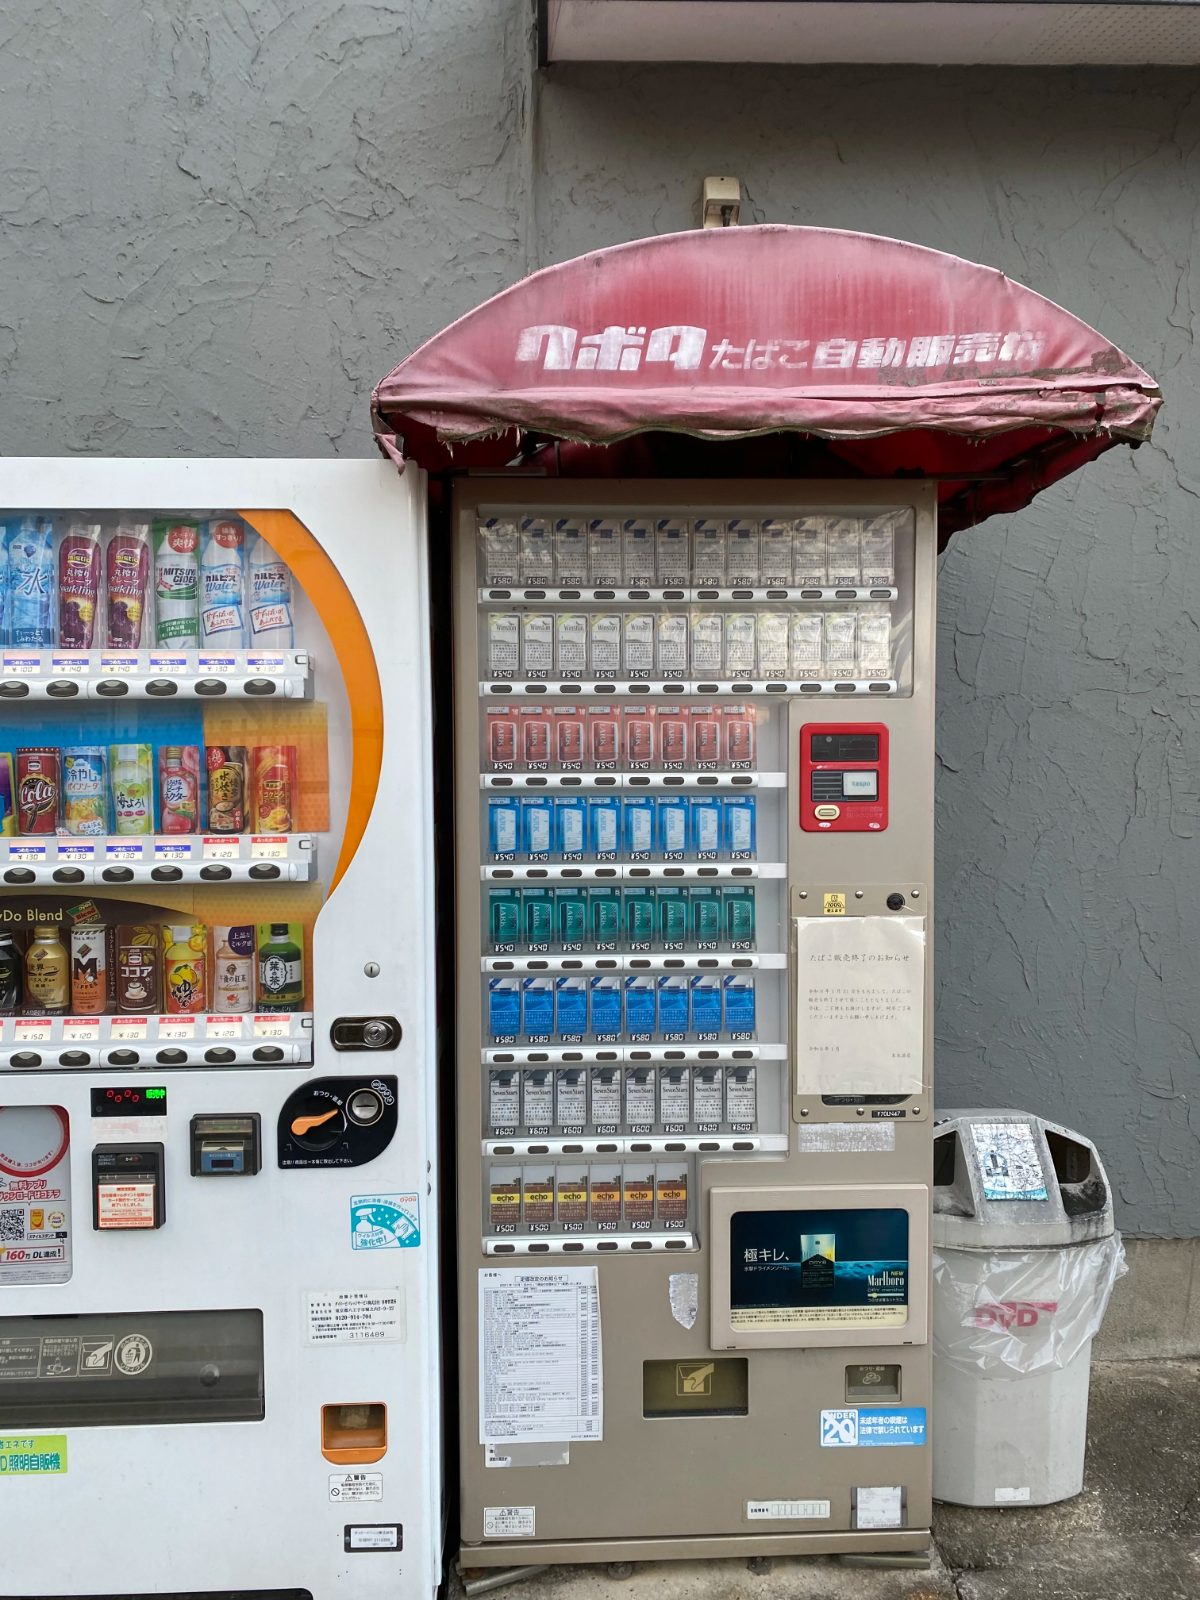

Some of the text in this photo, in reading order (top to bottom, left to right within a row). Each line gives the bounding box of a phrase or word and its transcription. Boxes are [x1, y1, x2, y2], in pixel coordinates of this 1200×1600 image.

[172, 538, 194, 548] 爽快
[206, 572, 236, 582] カルピス
[254, 572, 285, 580] カルピス
[496, 622, 516, 632] Winston
[563, 622, 584, 632] Winston
[597, 622, 618, 632] Winston
[68, 769, 97, 782] 冷やし
[21, 781, 55, 804] Cola
[27, 908, 63, 921] Blend
[232, 932, 250, 940] 上品な
[808, 953, 910, 962] たばこ販売終了のお知らせ
[74, 958, 98, 980] M
[120, 966, 153, 978] ココア
[269, 960, 280, 986] 葉の茶
[9, 1180, 47, 1192] 無料アプリ
[360, 1234, 388, 1247] 強化中!
[744, 1248, 790, 1263] 極キレ、
[868, 1270, 905, 1287] Marlboro
[860, 1416, 908, 1424] 未成年者の喫煙は
[860, 1426, 924, 1434] 法律で禁じられています
